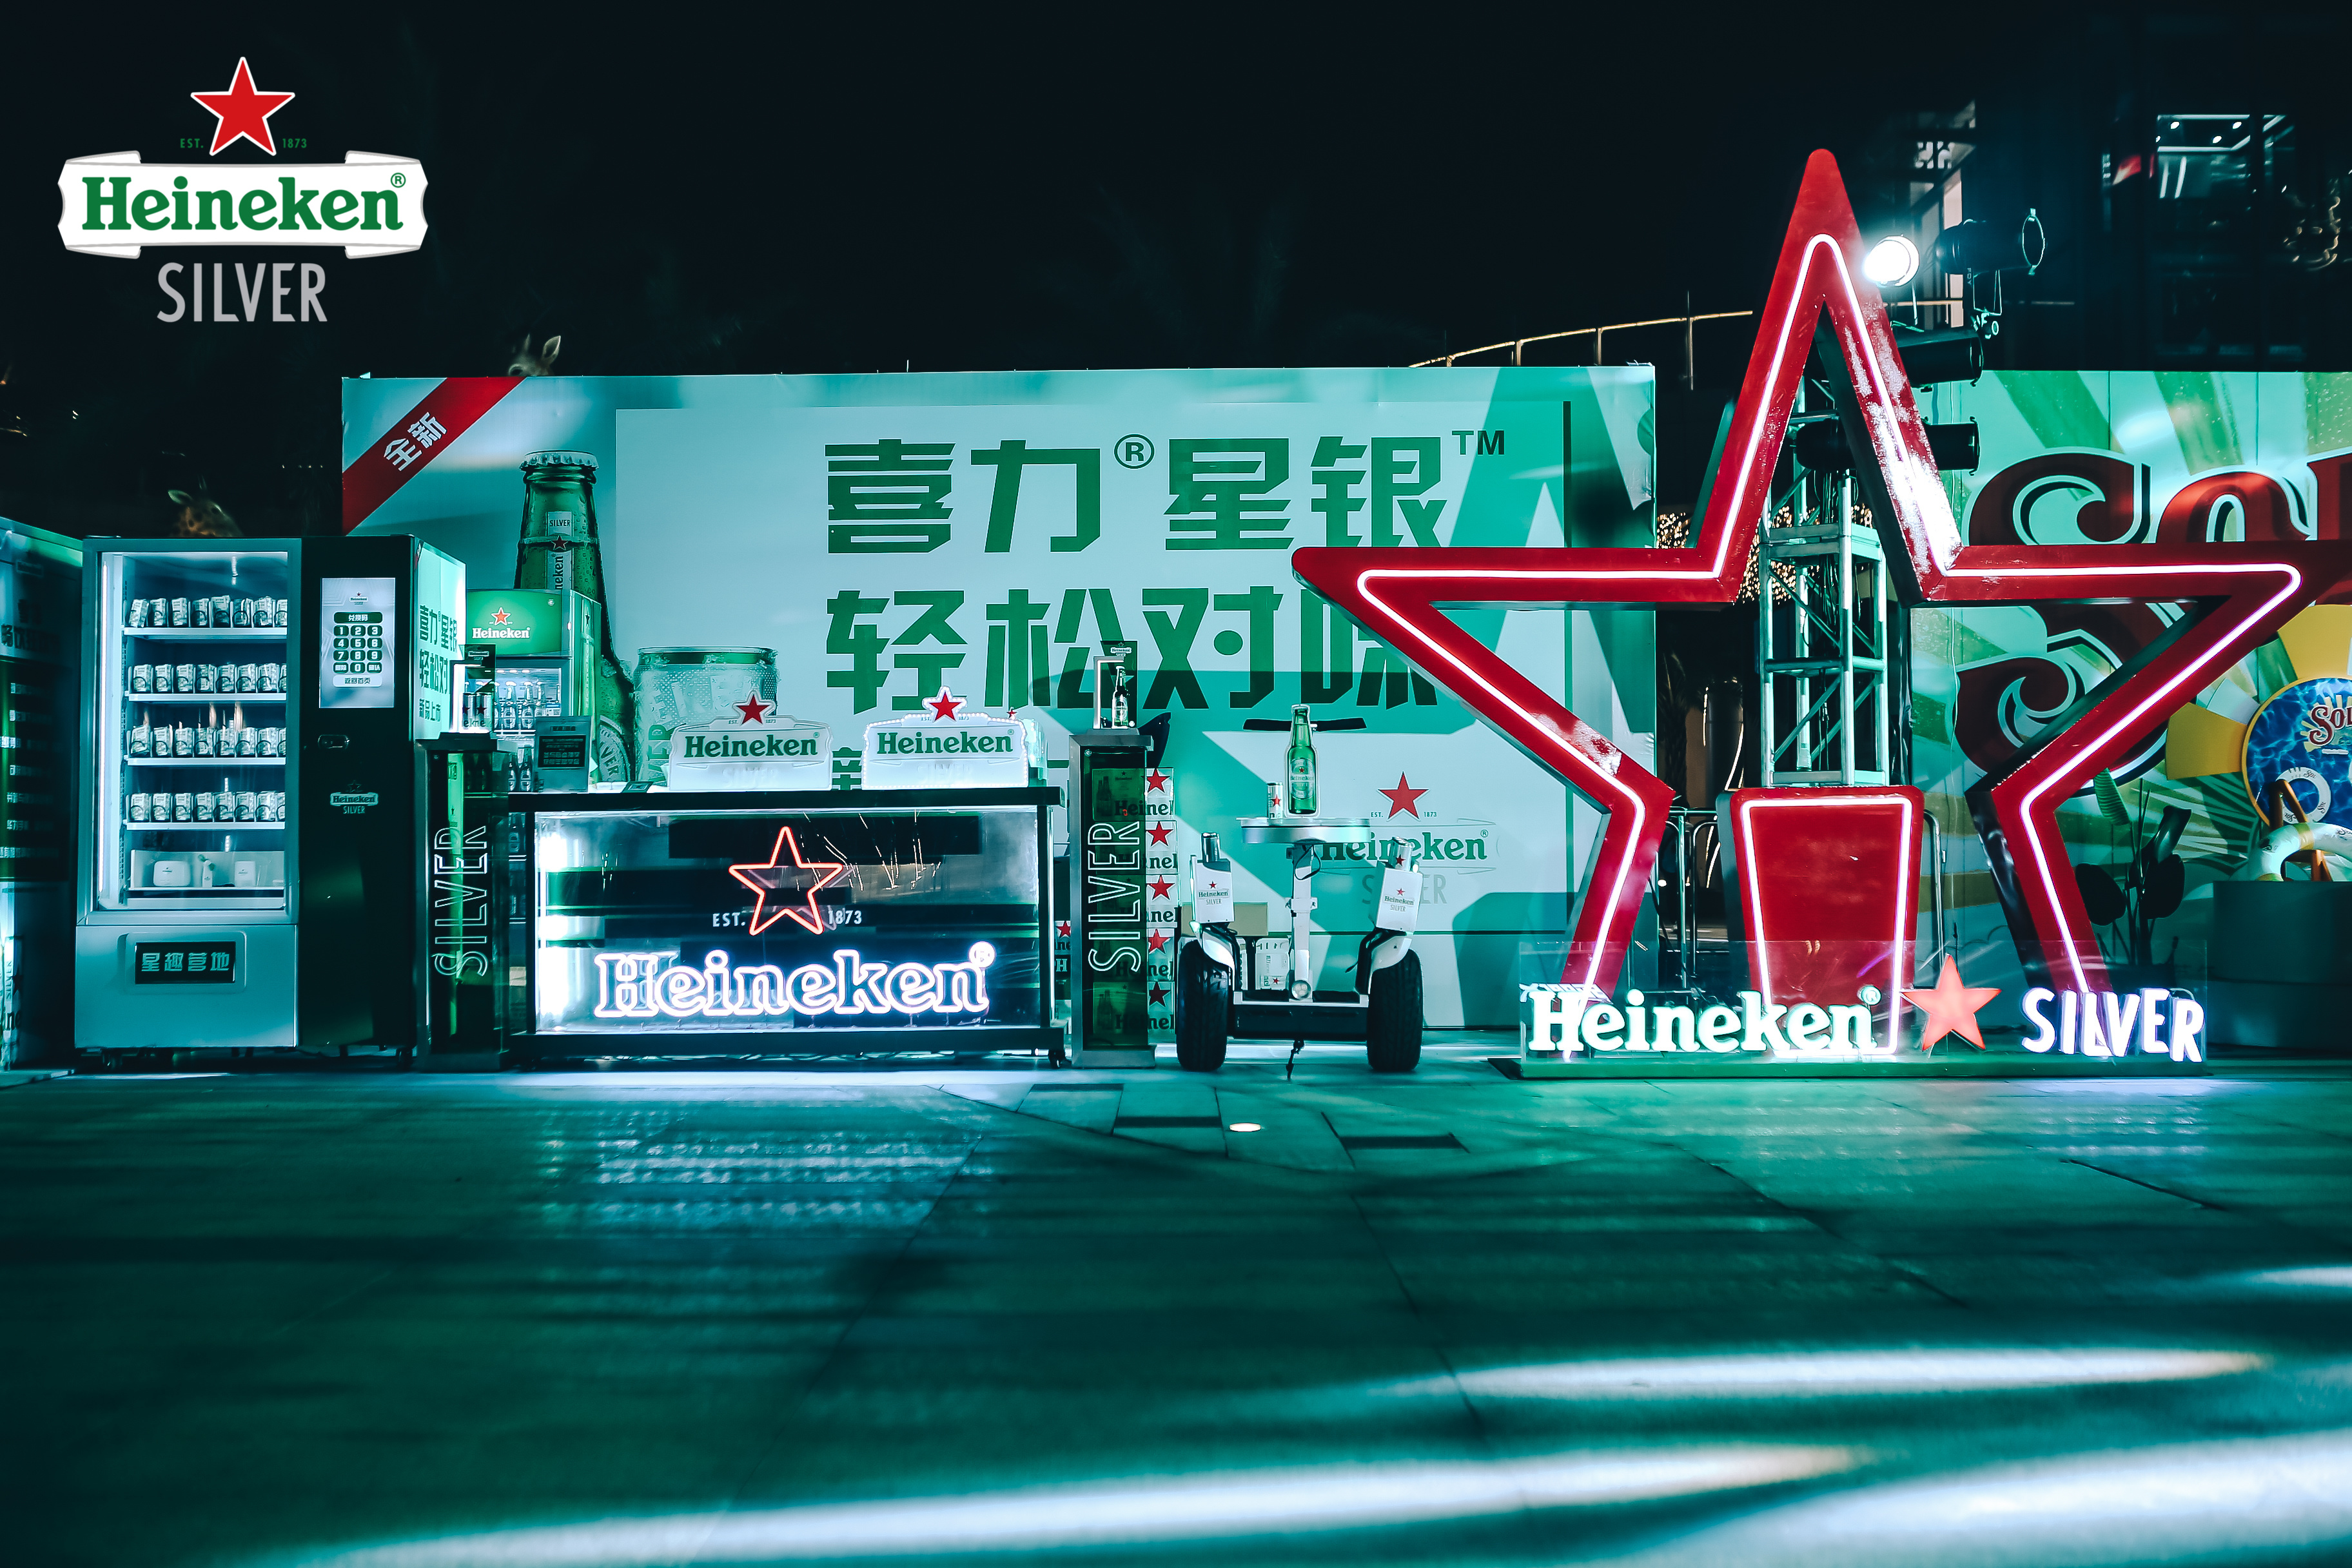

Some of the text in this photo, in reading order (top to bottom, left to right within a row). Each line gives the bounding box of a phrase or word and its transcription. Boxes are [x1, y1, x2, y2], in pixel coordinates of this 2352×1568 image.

[384, 412, 447, 471] 全新
[339, 627, 378, 635] 1 2 3
[338, 639, 378, 647] 4 5 6
[338, 651, 378, 660] 7 8 9
[343, 806, 366, 814] SILVER
[434, 825, 488, 976] SILVER
[1087, 821, 1141, 972] SILVER
[712, 908, 863, 928] EST. 1873
[1390, 904, 1406, 912] SILVER
[141, 952, 230, 972] 星趣营地
[2019, 986, 2204, 1063] SILVER
